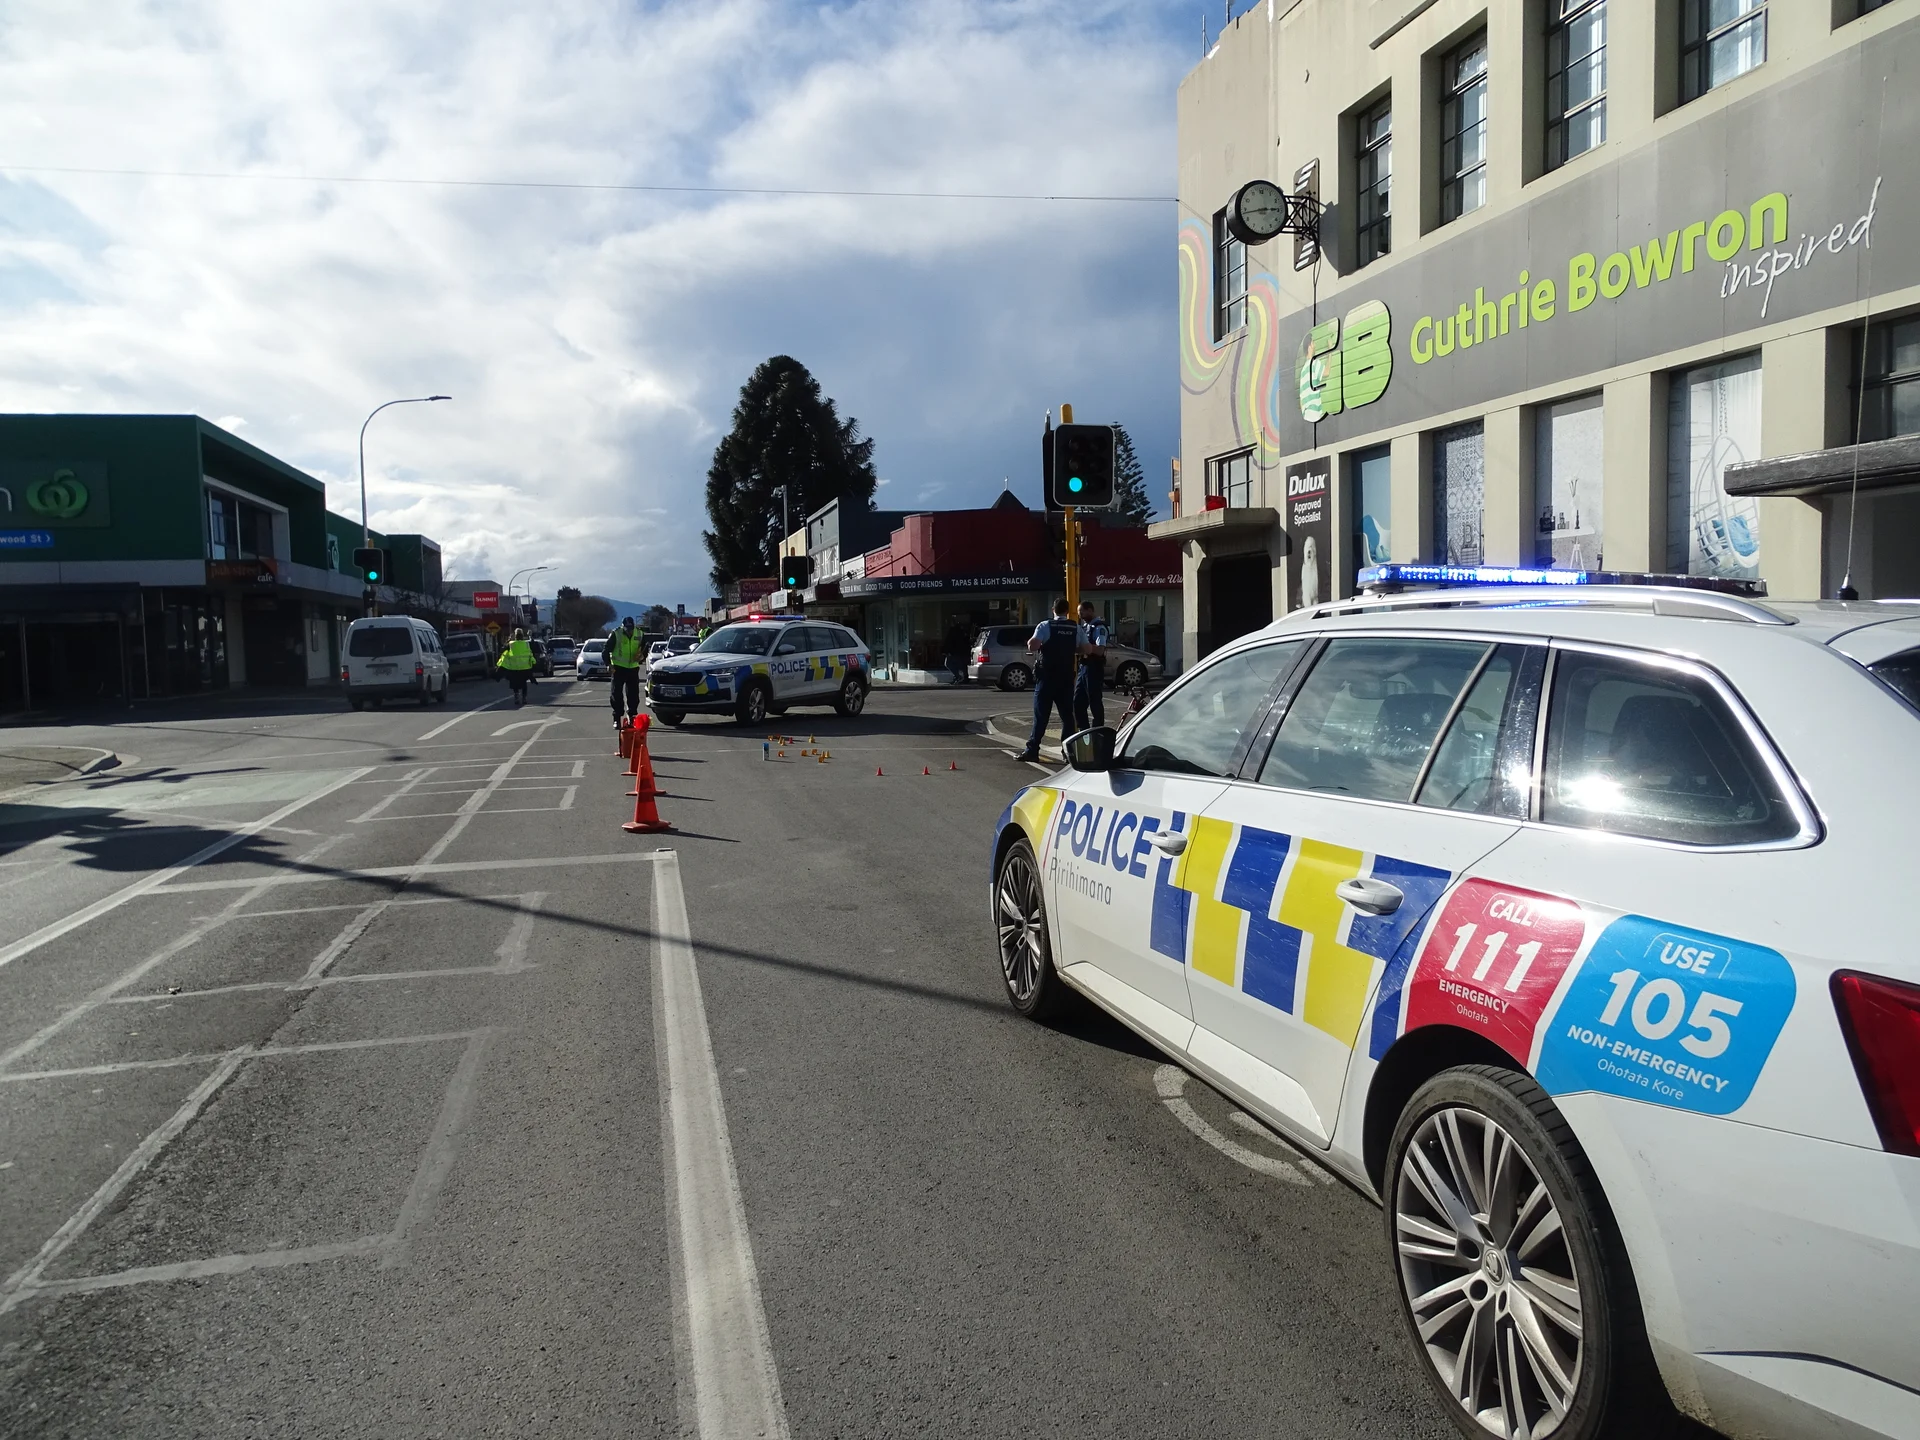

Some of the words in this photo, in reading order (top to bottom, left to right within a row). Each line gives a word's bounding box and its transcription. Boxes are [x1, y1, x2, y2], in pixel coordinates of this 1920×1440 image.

[1721, 176, 1882, 318] inspired
[1409, 269, 1556, 365] Guthrie
[1567, 191, 1790, 313] Bowron
[1295, 299, 1392, 423] GB
[1288, 472, 1327, 496] Dulux
[1293, 498, 1322, 514] Approved
[1293, 511, 1322, 527] Specialist
[30, 534, 42, 543] St
[257, 572, 274, 582] cafe
[865, 583, 877, 591] GOOD
[878, 582, 893, 590] TIMES
[900, 581, 916, 589] GOOD
[917, 580, 943, 588] FRIENDS
[951, 578, 972, 587] TAPAS
[973, 578, 979, 586] &
[980, 577, 1000, 586] LIGHT
[1001, 576, 1029, 585] SNACKS
[1095, 574, 1116, 586] Great
[1118, 574, 1135, 585] Beer
[1136, 575, 1144, 584] &
[1146, 574, 1166, 584] Wine
[771, 660, 805, 676] POLICE
[1053, 799, 1161, 880] POLICE
[1048, 856, 1113, 906] Pirihimana
[1488, 899, 1534, 928] CALL
[1444, 922, 1543, 994] 111
[1660, 941, 1716, 975] USE
[1438, 978, 1510, 1015] EMERGENCY
[1456, 1003, 1490, 1025] Ohotata
[1599, 968, 1745, 1060] 105
[1566, 1024, 1730, 1094] NON-EMERGENCY
[1596, 1058, 1650, 1091] Ohotata
[1652, 1078, 1685, 1101] Kore
